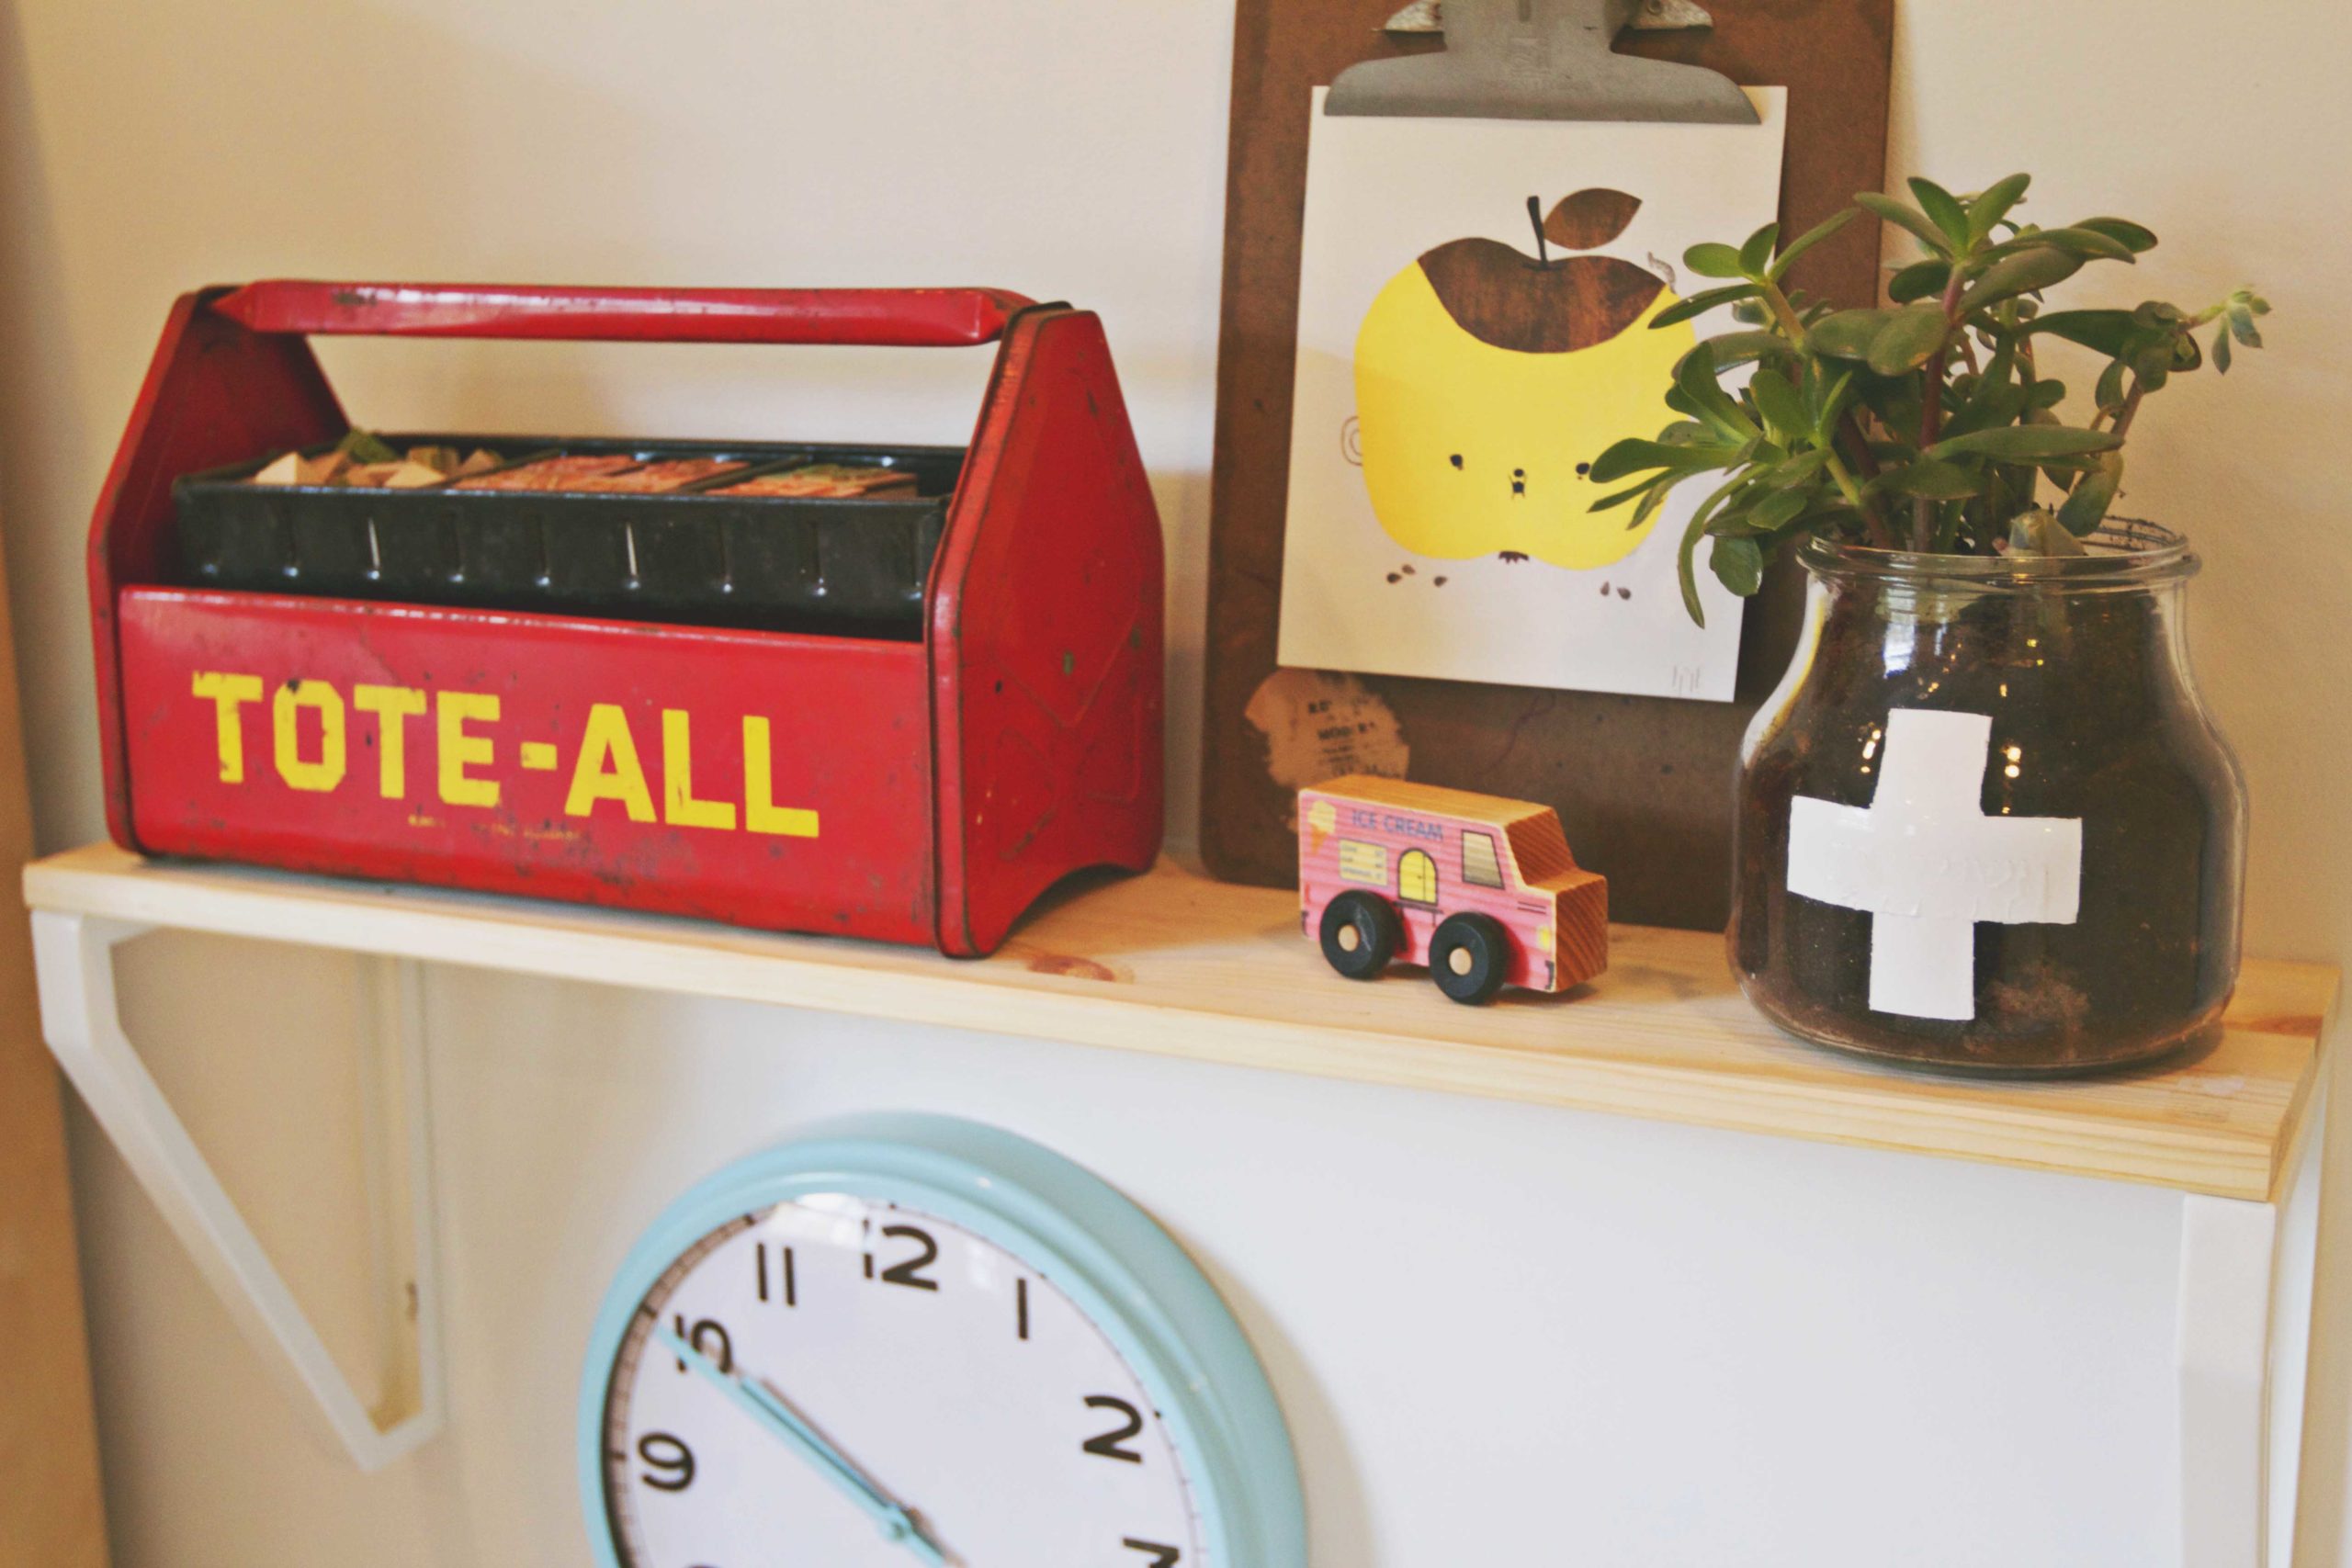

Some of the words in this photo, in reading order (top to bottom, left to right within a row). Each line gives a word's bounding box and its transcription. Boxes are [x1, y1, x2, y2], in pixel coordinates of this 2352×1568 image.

[191, 671, 820, 840] TOTE-ALL
[1351, 809, 1376, 829] ICE
[1384, 814, 1443, 840] CREAM
[756, 1242, 797, 1308] 11
[863, 1218, 939, 1292] 12
[1016, 1278, 1029, 1341] 1
[638, 1431, 696, 1493] 9
[1082, 1395, 1143, 1464] 2
